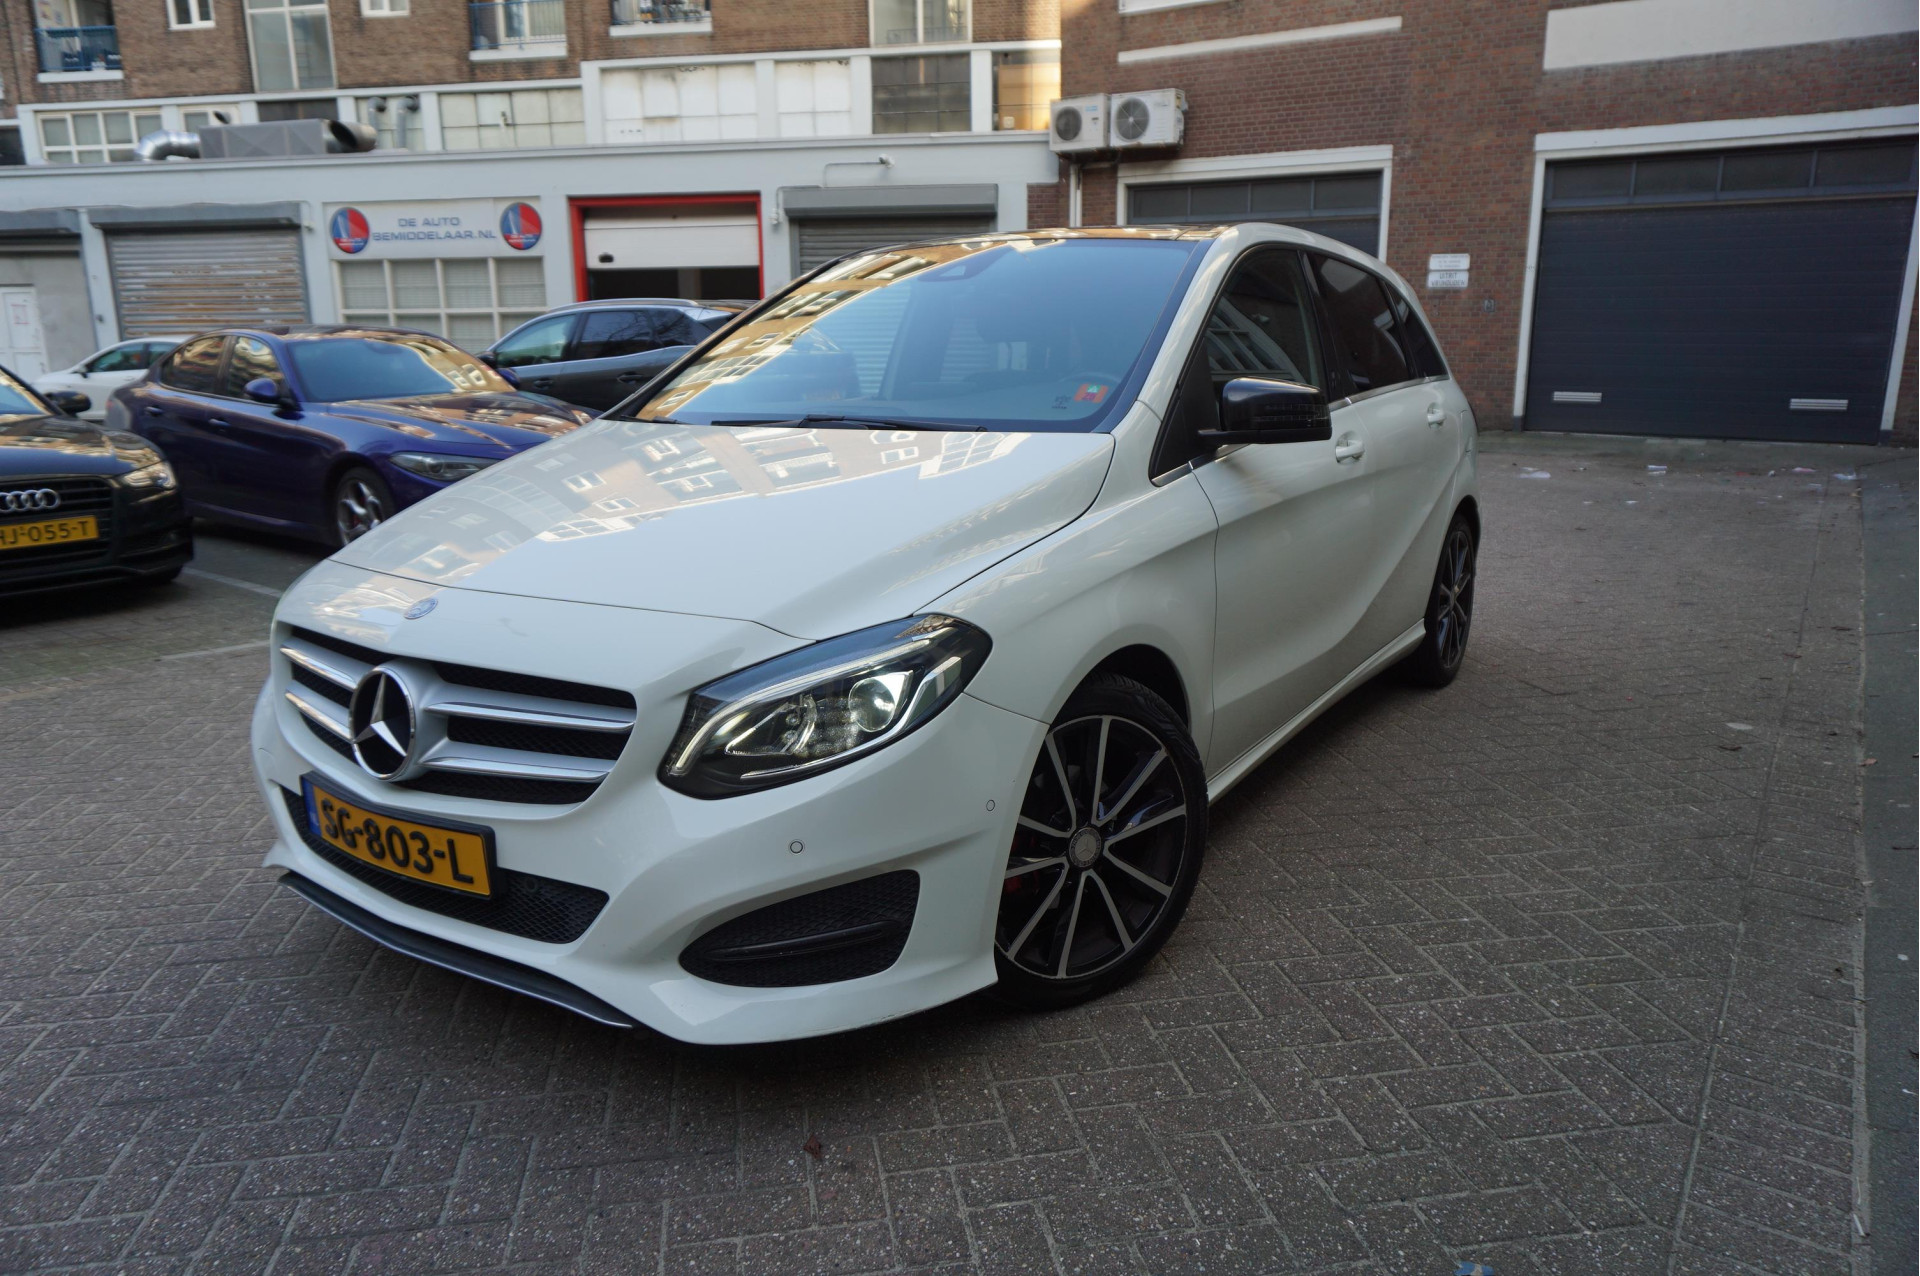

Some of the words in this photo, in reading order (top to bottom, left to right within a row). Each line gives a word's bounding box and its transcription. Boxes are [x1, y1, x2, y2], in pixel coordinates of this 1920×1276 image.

[398, 218, 416, 227] DE
[422, 217, 460, 226] AUTO
[372, 230, 496, 241] BEMIDDELAAR.NL
[322, 798, 474, 884] SG-803-L
